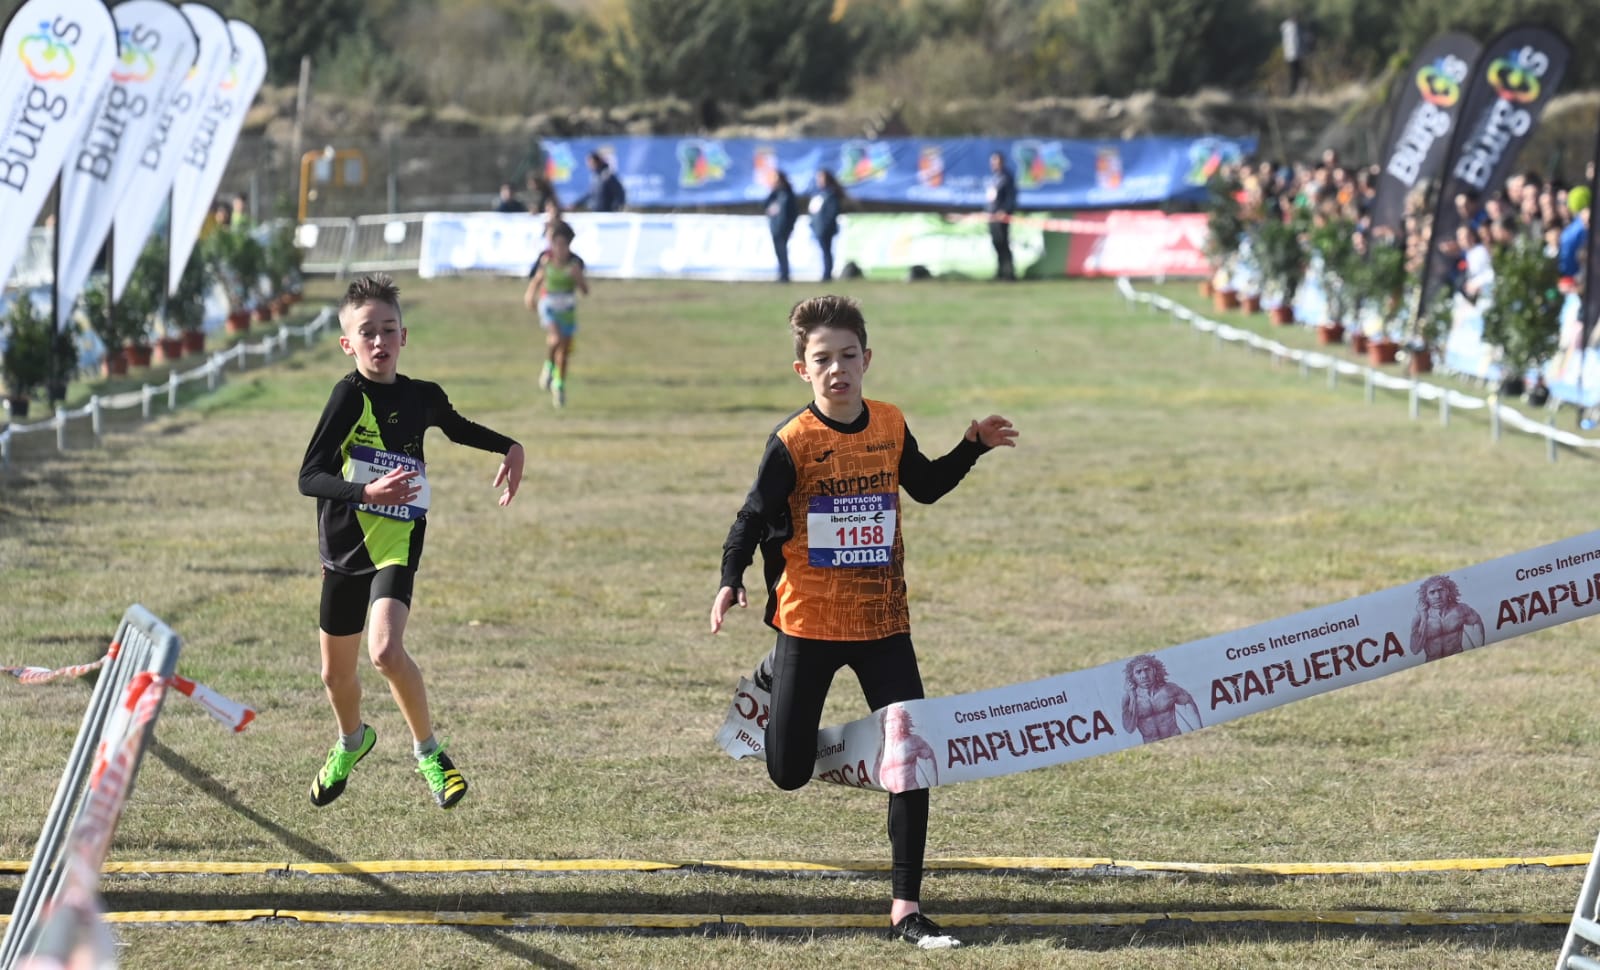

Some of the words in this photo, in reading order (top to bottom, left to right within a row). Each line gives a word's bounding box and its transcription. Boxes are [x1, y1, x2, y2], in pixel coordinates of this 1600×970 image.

[375, 450, 417, 466] DIPUTACIÓN
[368, 465, 391, 476] iberC
[817, 469, 896, 496] Norpetr
[833, 495, 883, 505] DIPUTACIÓN
[833, 503, 883, 513] BURGOS
[835, 525, 885, 547] 1158
[1515, 563, 1553, 582] Cross
[1556, 549, 1600, 570] Interna
[1226, 641, 1267, 661] Cross
[1268, 613, 1361, 650] Internacional
[1210, 630, 1406, 711] ATAPUERCA
[954, 710, 988, 724] Cross
[989, 691, 1068, 718] Internacional
[816, 739, 846, 760] acional
[946, 709, 1116, 769] ATAPUERCA
